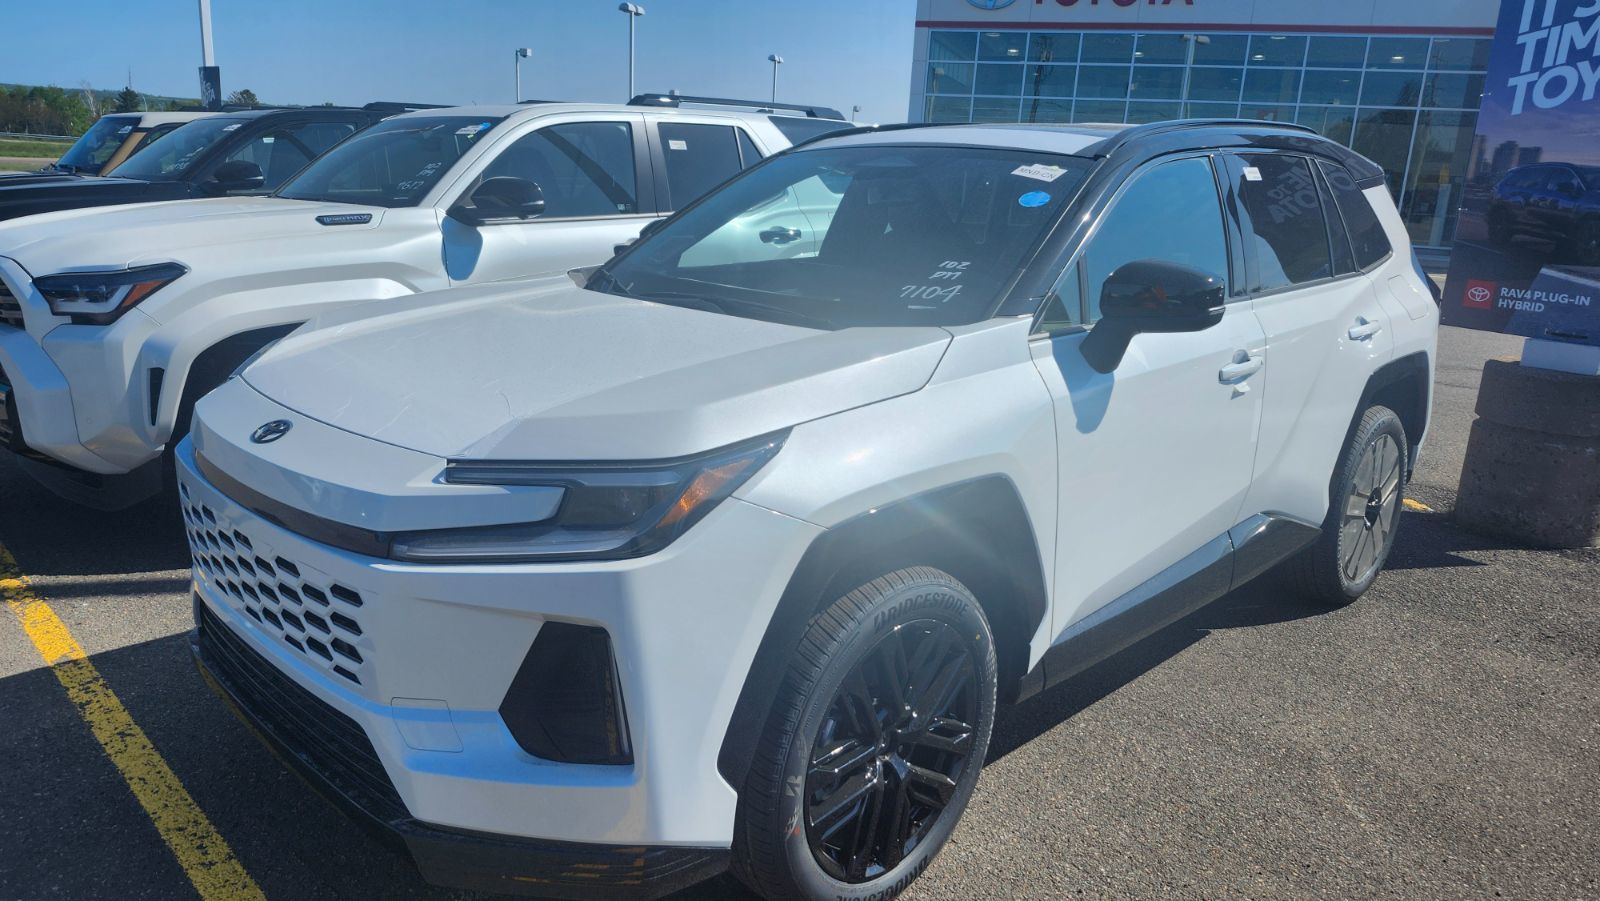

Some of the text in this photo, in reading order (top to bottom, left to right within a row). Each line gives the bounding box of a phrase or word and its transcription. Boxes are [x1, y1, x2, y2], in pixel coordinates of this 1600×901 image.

[900, 284, 963, 303] 7104
[1500, 287, 1591, 306] RAV4 PLUG-IN
[1498, 299, 1545, 313] HYBRID
[873, 591, 970, 635] BRIDGESTONE
